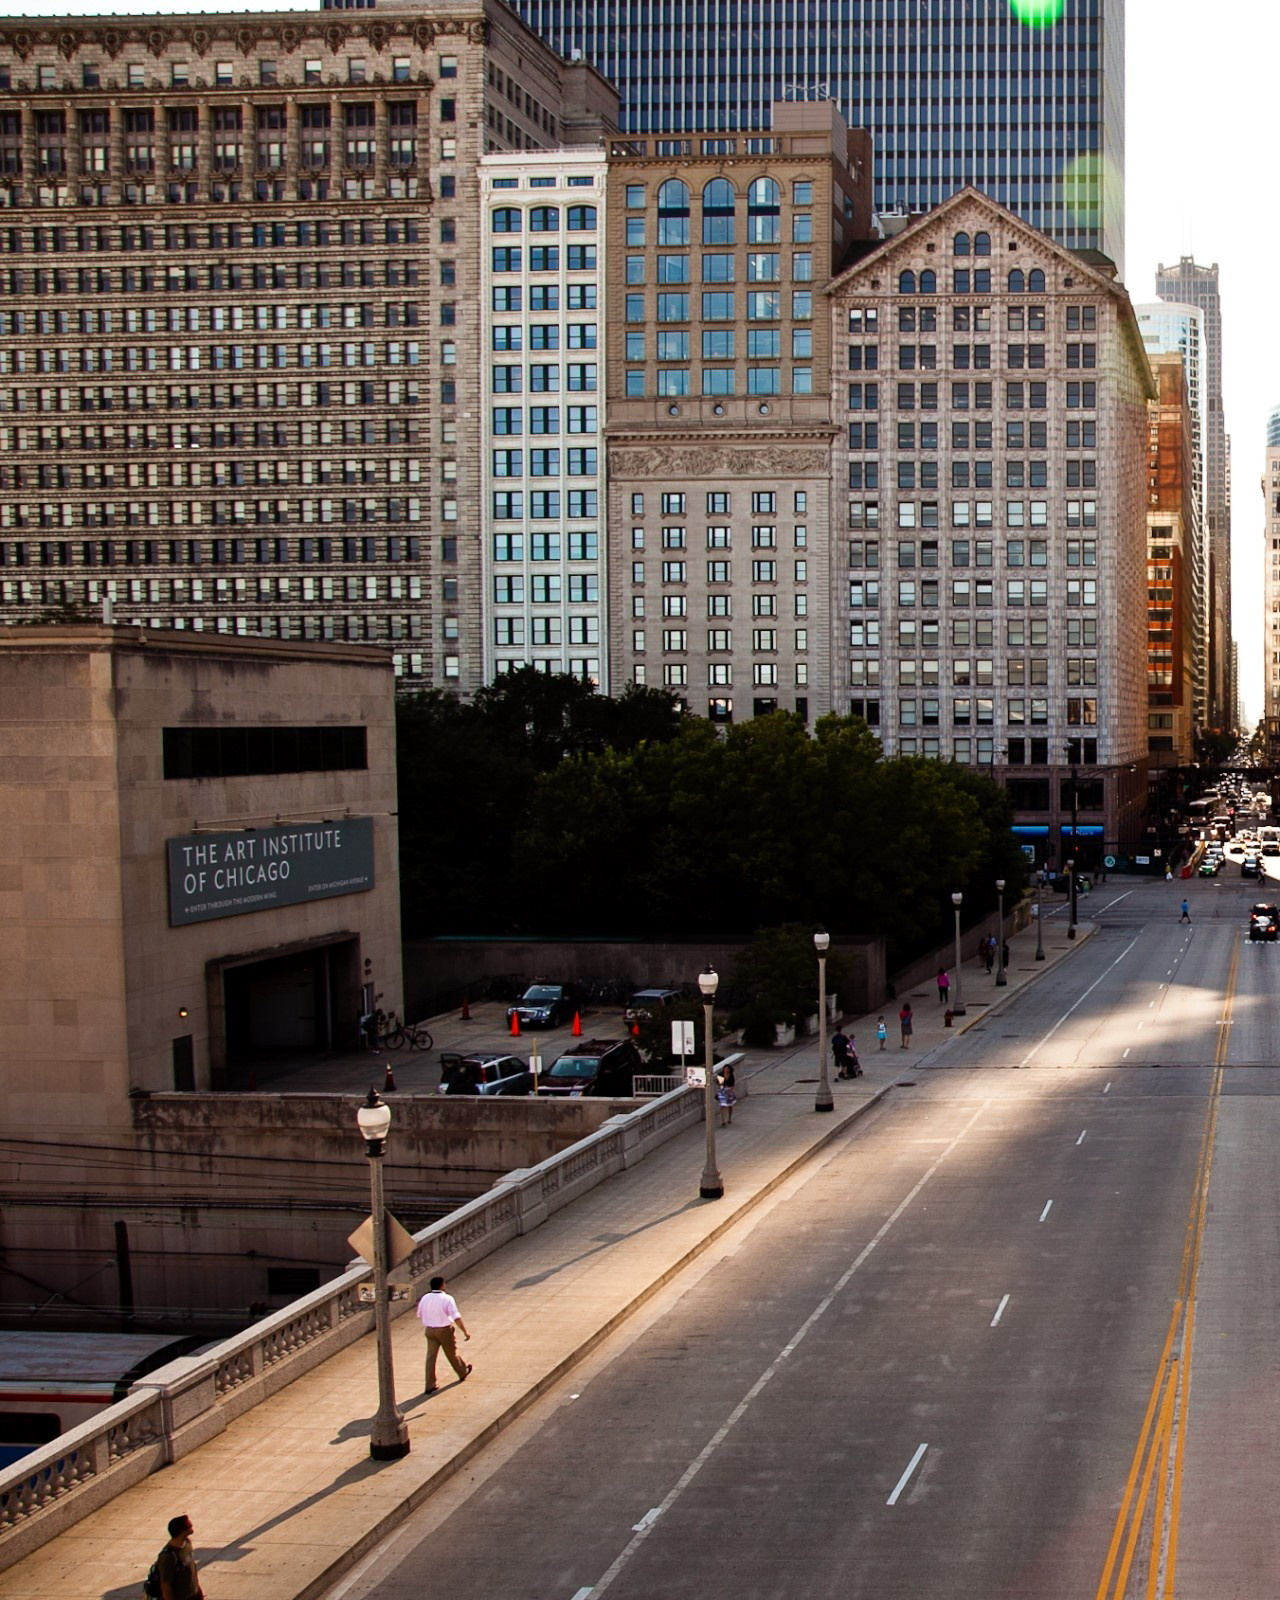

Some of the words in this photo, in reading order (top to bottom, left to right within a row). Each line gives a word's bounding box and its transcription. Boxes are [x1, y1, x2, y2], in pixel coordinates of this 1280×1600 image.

[183, 844, 217, 867] THE
[224, 839, 256, 861] ART
[263, 830, 341, 856] INSTITUTE
[184, 872, 207, 894] OF
[214, 860, 290, 889] CHICAGO
[190, 904, 207, 913] ENTER
[207, 899, 233, 909] THROUGH
[243, 894, 263, 903] MODERN
[264, 891, 277, 899] WING
